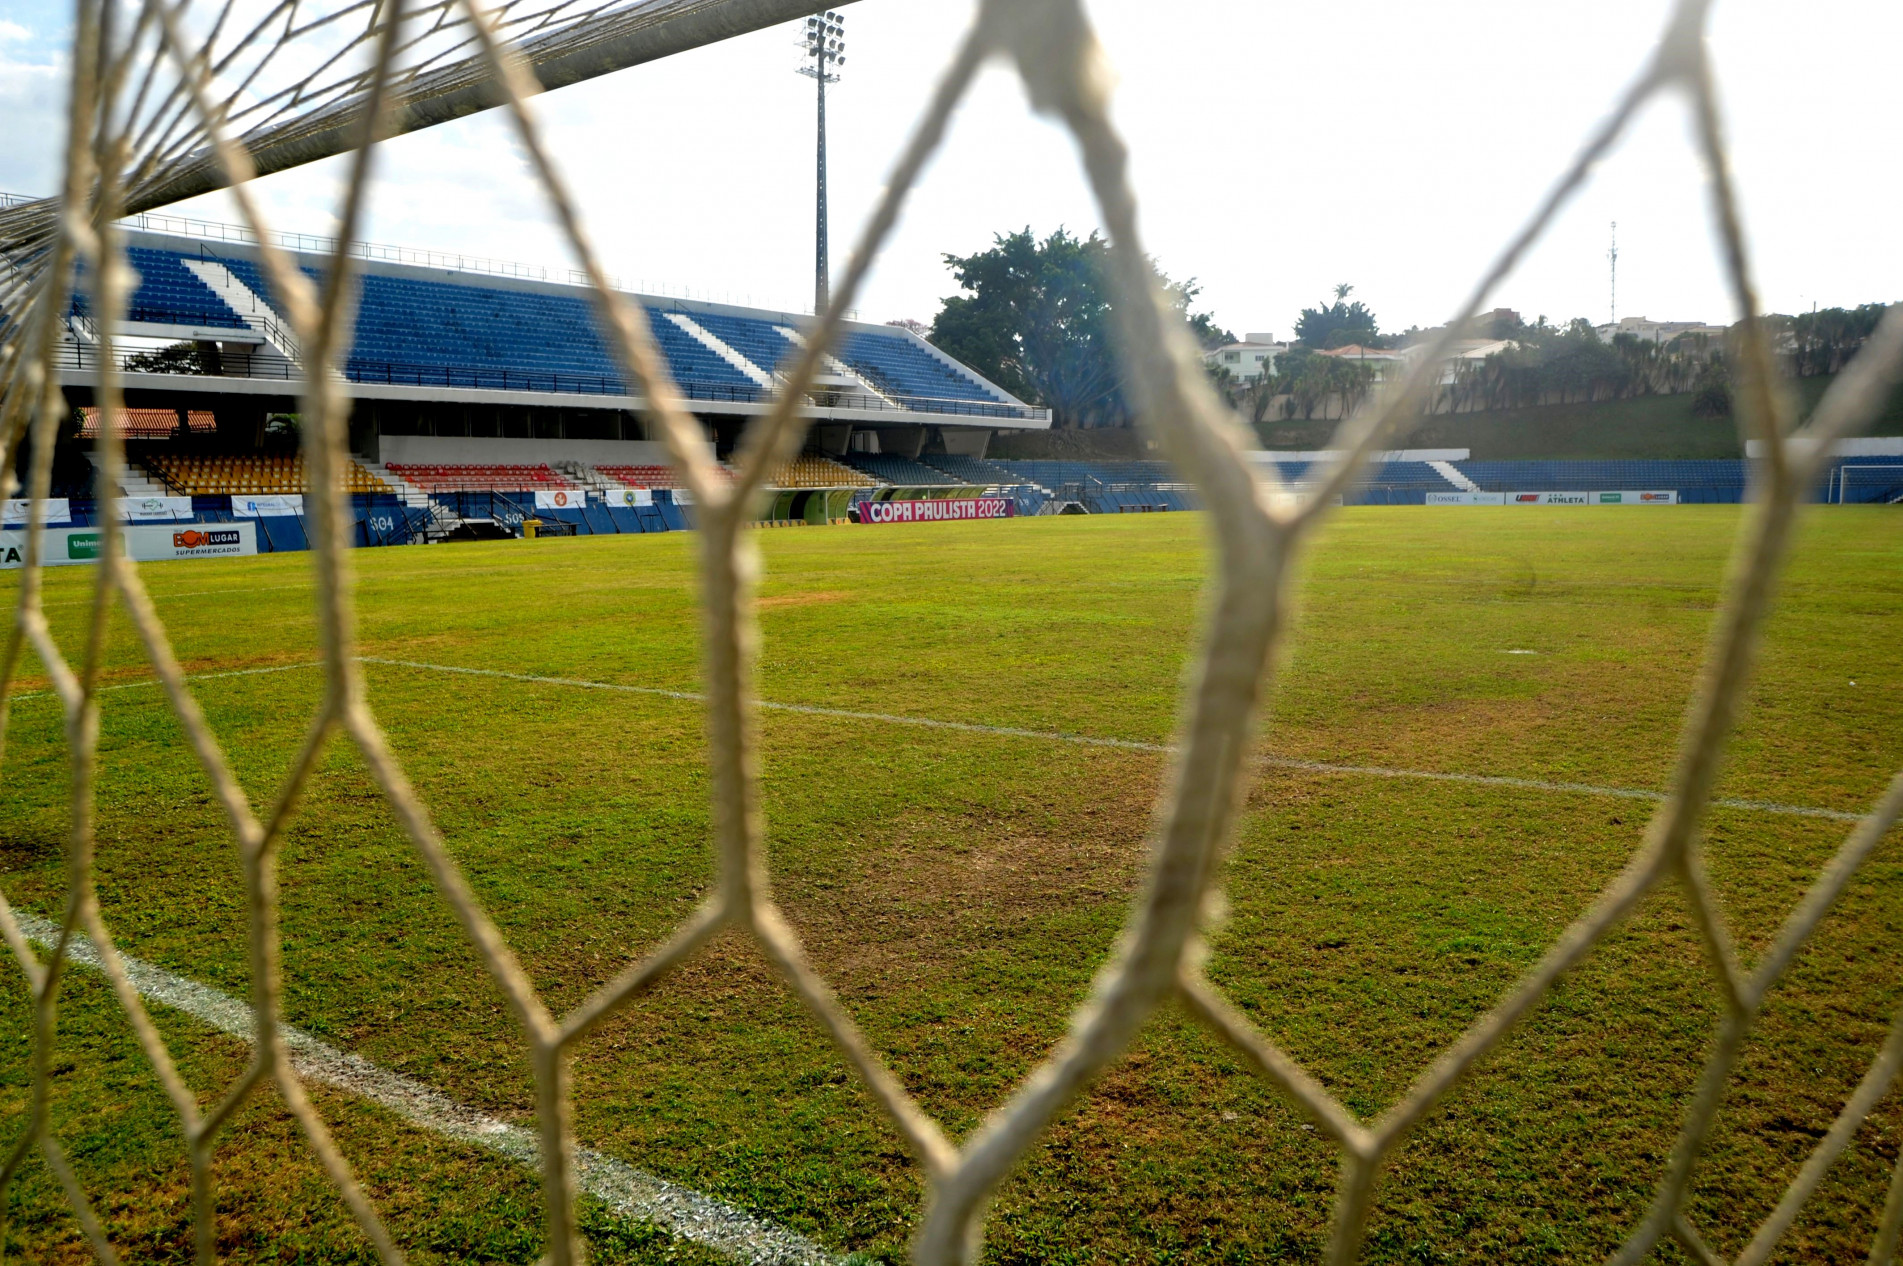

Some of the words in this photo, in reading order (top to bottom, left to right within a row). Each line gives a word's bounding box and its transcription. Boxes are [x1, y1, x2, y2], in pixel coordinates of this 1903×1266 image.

[870, 502, 912, 522] COPA
[915, 500, 976, 520] PAULISTA
[978, 500, 1006, 518] 2022
[173, 530, 209, 548] BOM
[210, 533, 238, 543] LUGAR
[175, 547, 241, 556] SUPERMERCADOS
